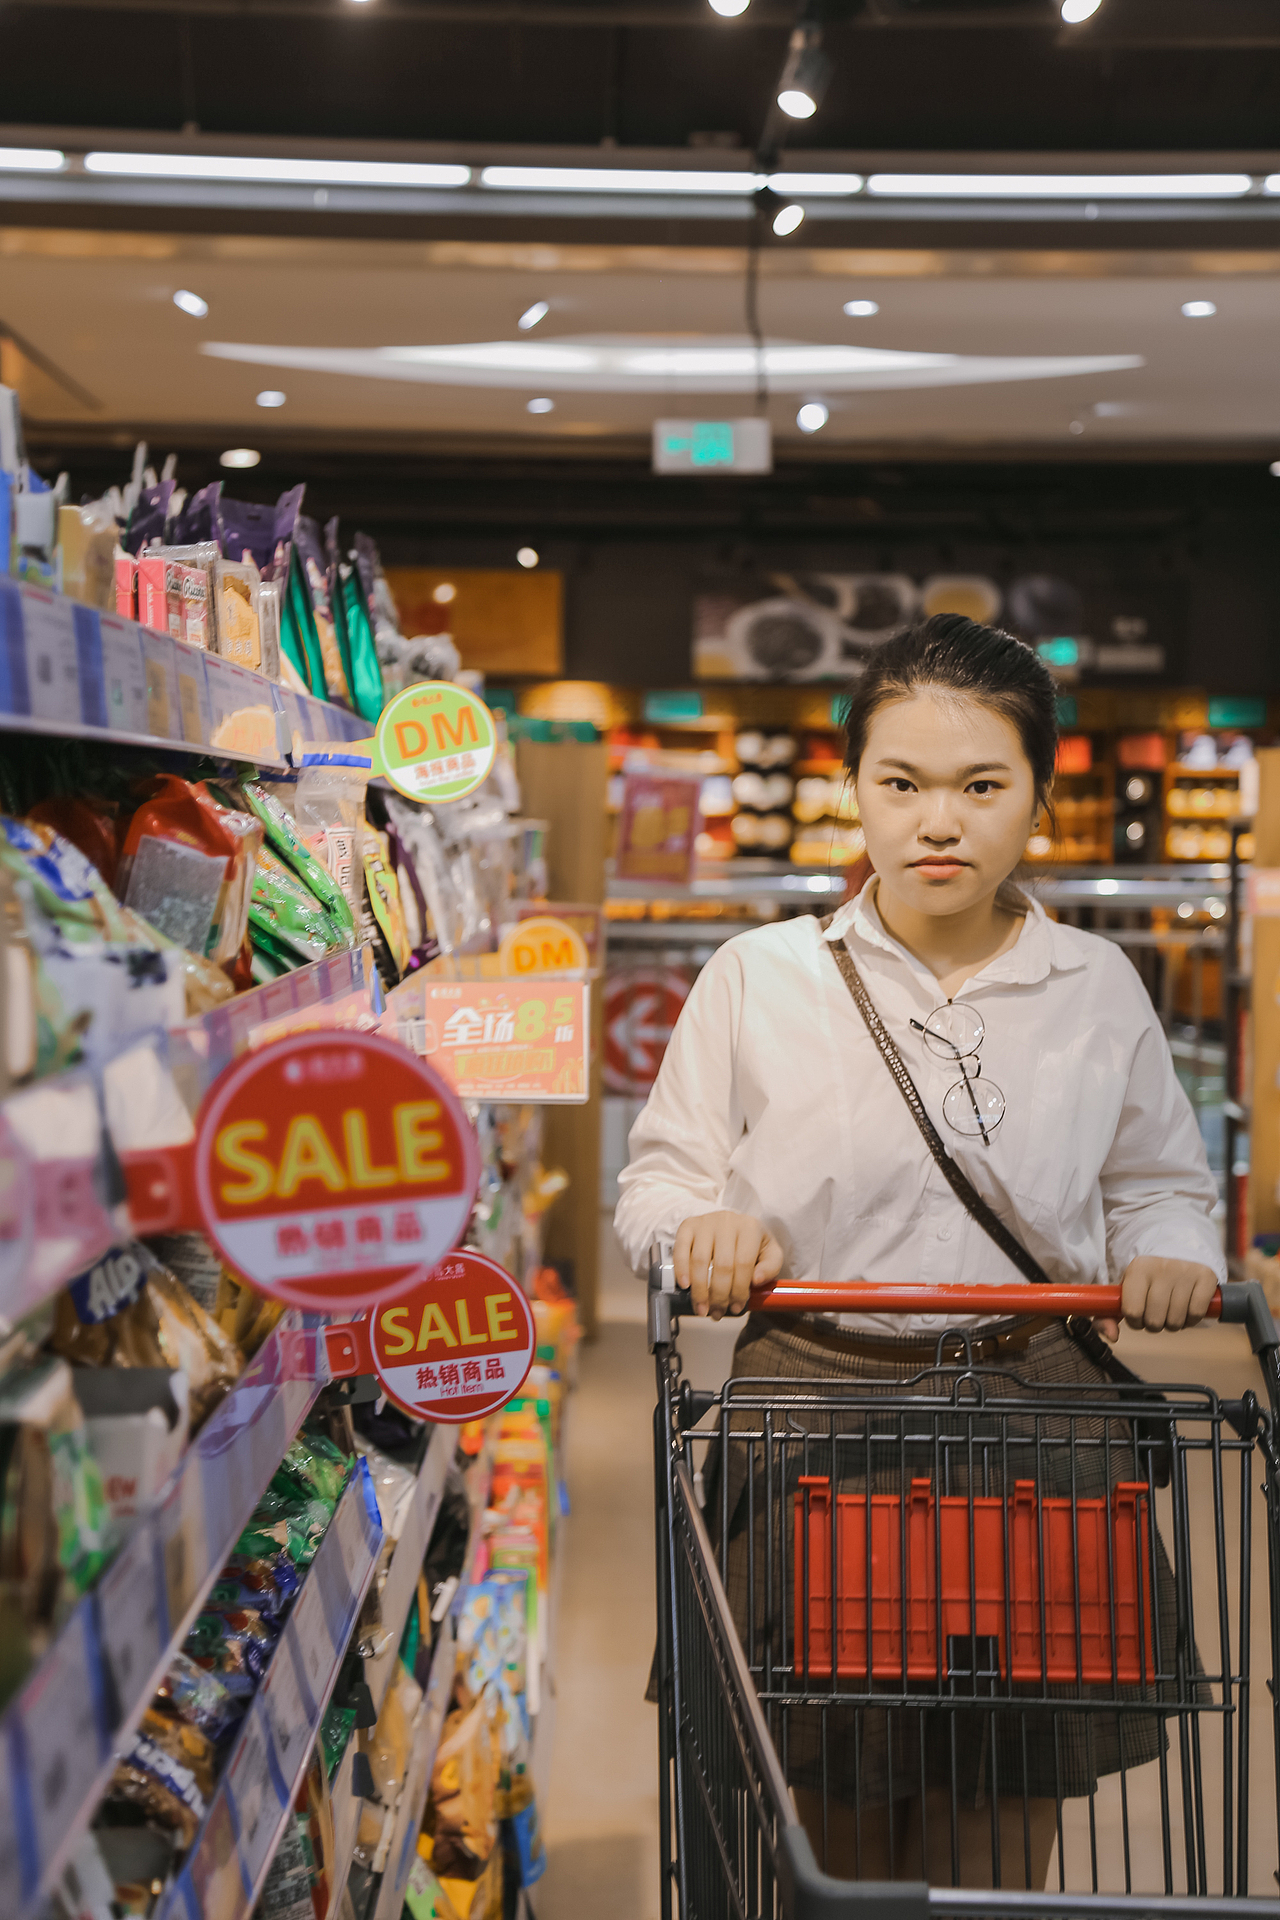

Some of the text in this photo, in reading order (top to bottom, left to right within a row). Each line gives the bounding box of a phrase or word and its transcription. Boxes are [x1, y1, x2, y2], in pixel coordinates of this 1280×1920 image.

[394, 705, 479, 760] DM
[514, 939, 573, 972] DM
[217, 1101, 449, 1204] SALE
[381, 1293, 518, 1356] SALE
[416, 1358, 505, 1390] 热销商品
[440, 1386, 459, 1397] Hot
